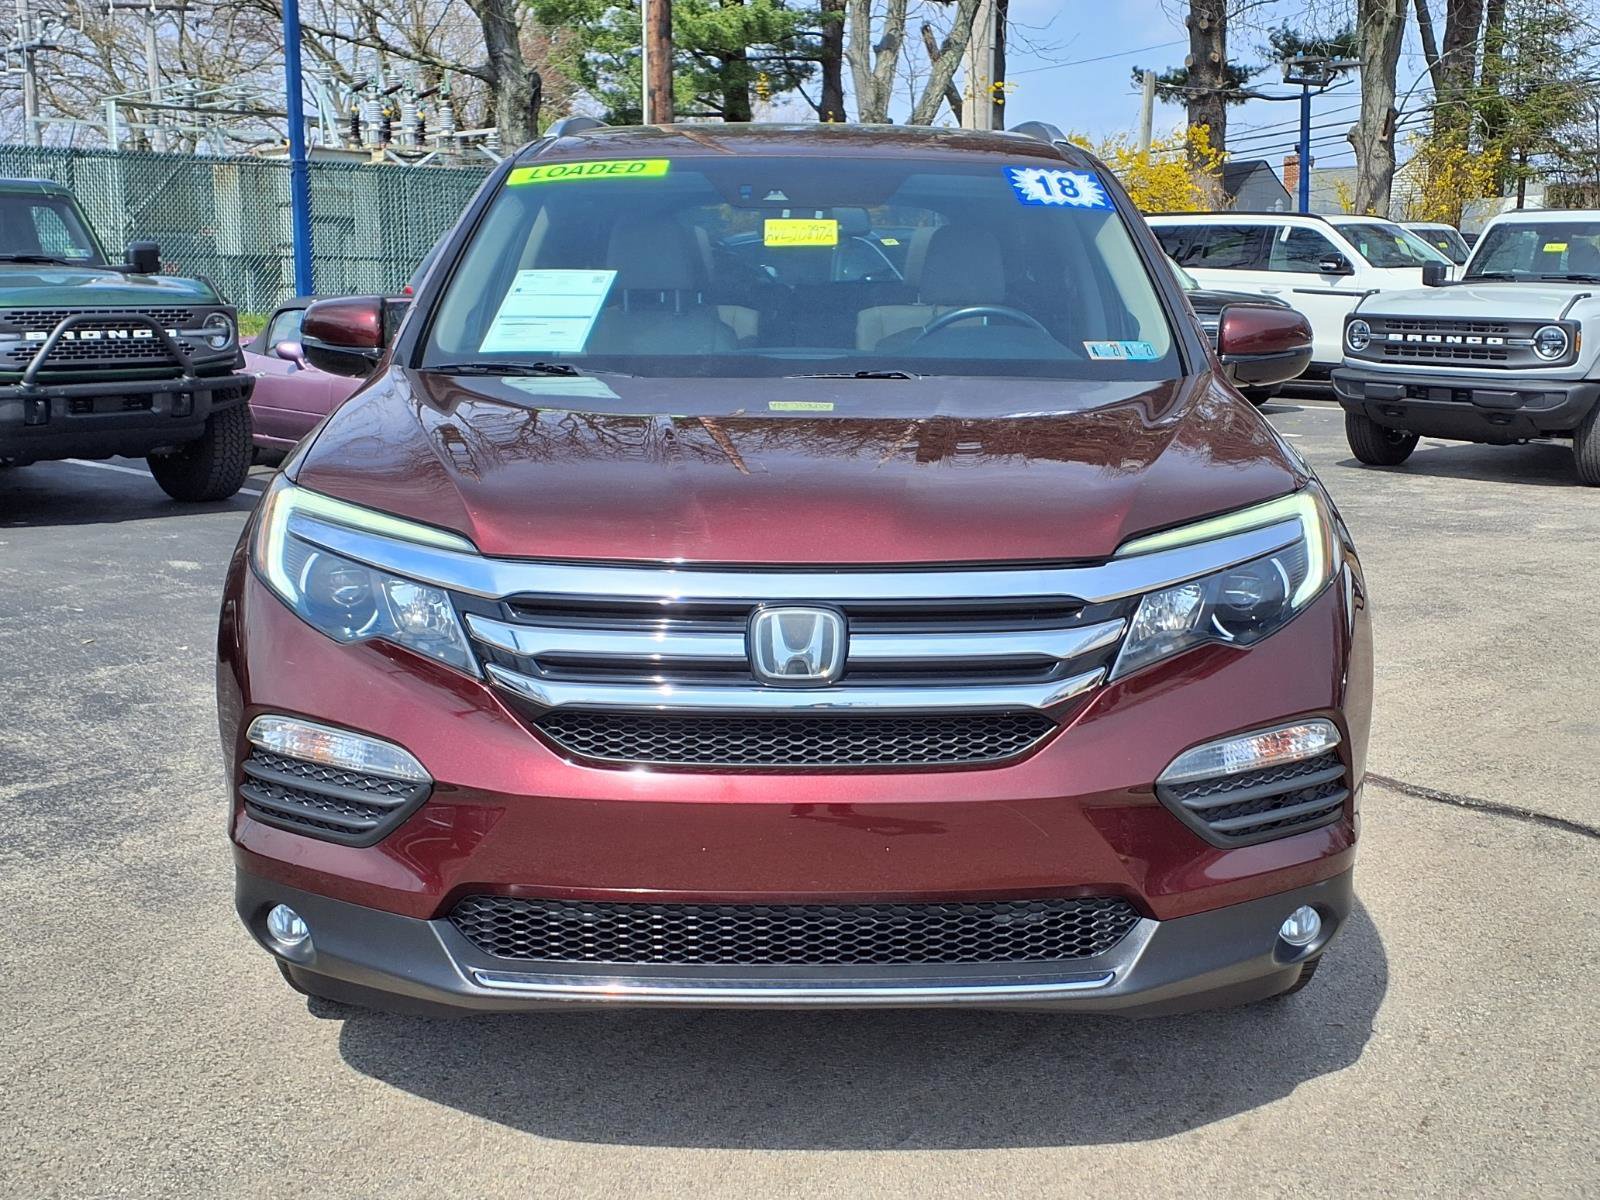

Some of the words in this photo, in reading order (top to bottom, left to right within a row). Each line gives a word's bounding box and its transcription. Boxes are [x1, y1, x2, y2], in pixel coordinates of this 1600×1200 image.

[529, 162, 647, 180] LOADED
[1035, 175, 1080, 198] 18
[1388, 333, 1504, 345] BRONCO
